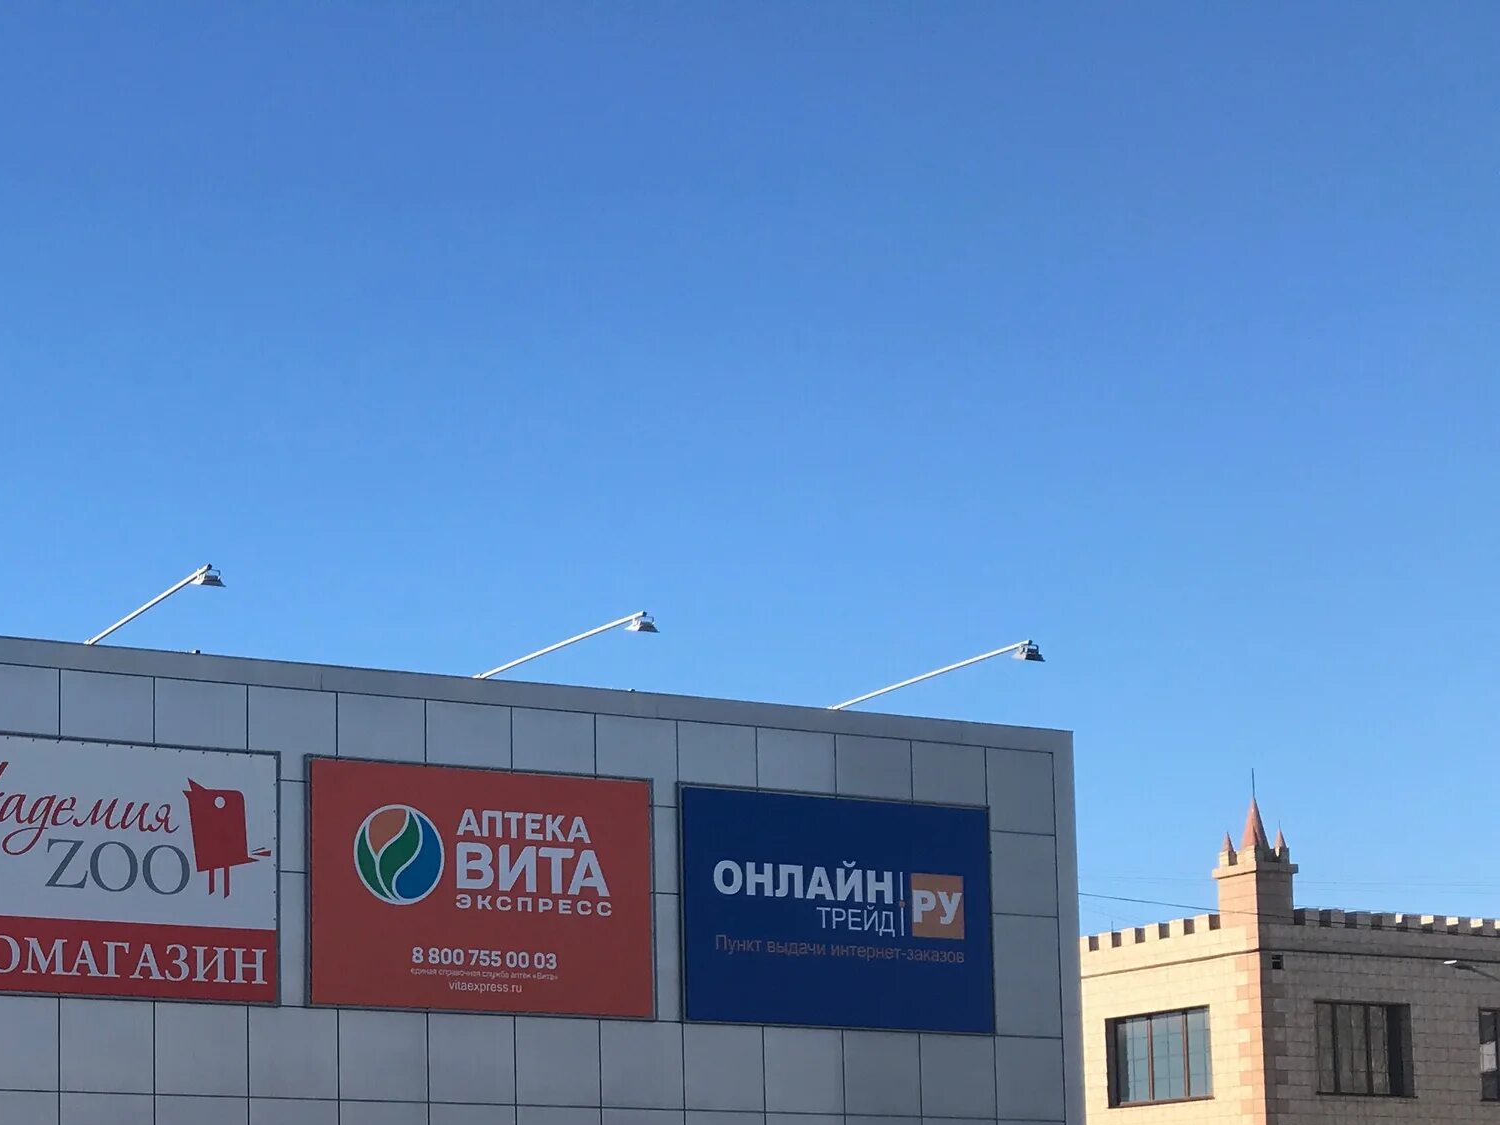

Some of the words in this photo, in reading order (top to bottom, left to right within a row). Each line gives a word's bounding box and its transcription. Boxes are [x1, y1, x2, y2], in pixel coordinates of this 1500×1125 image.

[456, 808, 592, 844] АПТЕКА
[44, 838, 191, 895] ZOO
[456, 841, 611, 897] ВИТА
[713, 859, 894, 904] ОНЛАЙН
[455, 894, 613, 917] ЭКСПРЕСС
[816, 905, 895, 937] ТРЕЙД
[411, 946, 424, 964] 8
[428, 947, 465, 966] 800
[469, 949, 502, 967] 755
[506, 951, 530, 969] 00
[534, 952, 558, 970] 03
[715, 934, 762, 954] Пункт
[766, 941, 827, 957] выдачи
[830, 945, 965, 964] интернет-заказов
[449, 979, 523, 994] vitaexpress.ru
